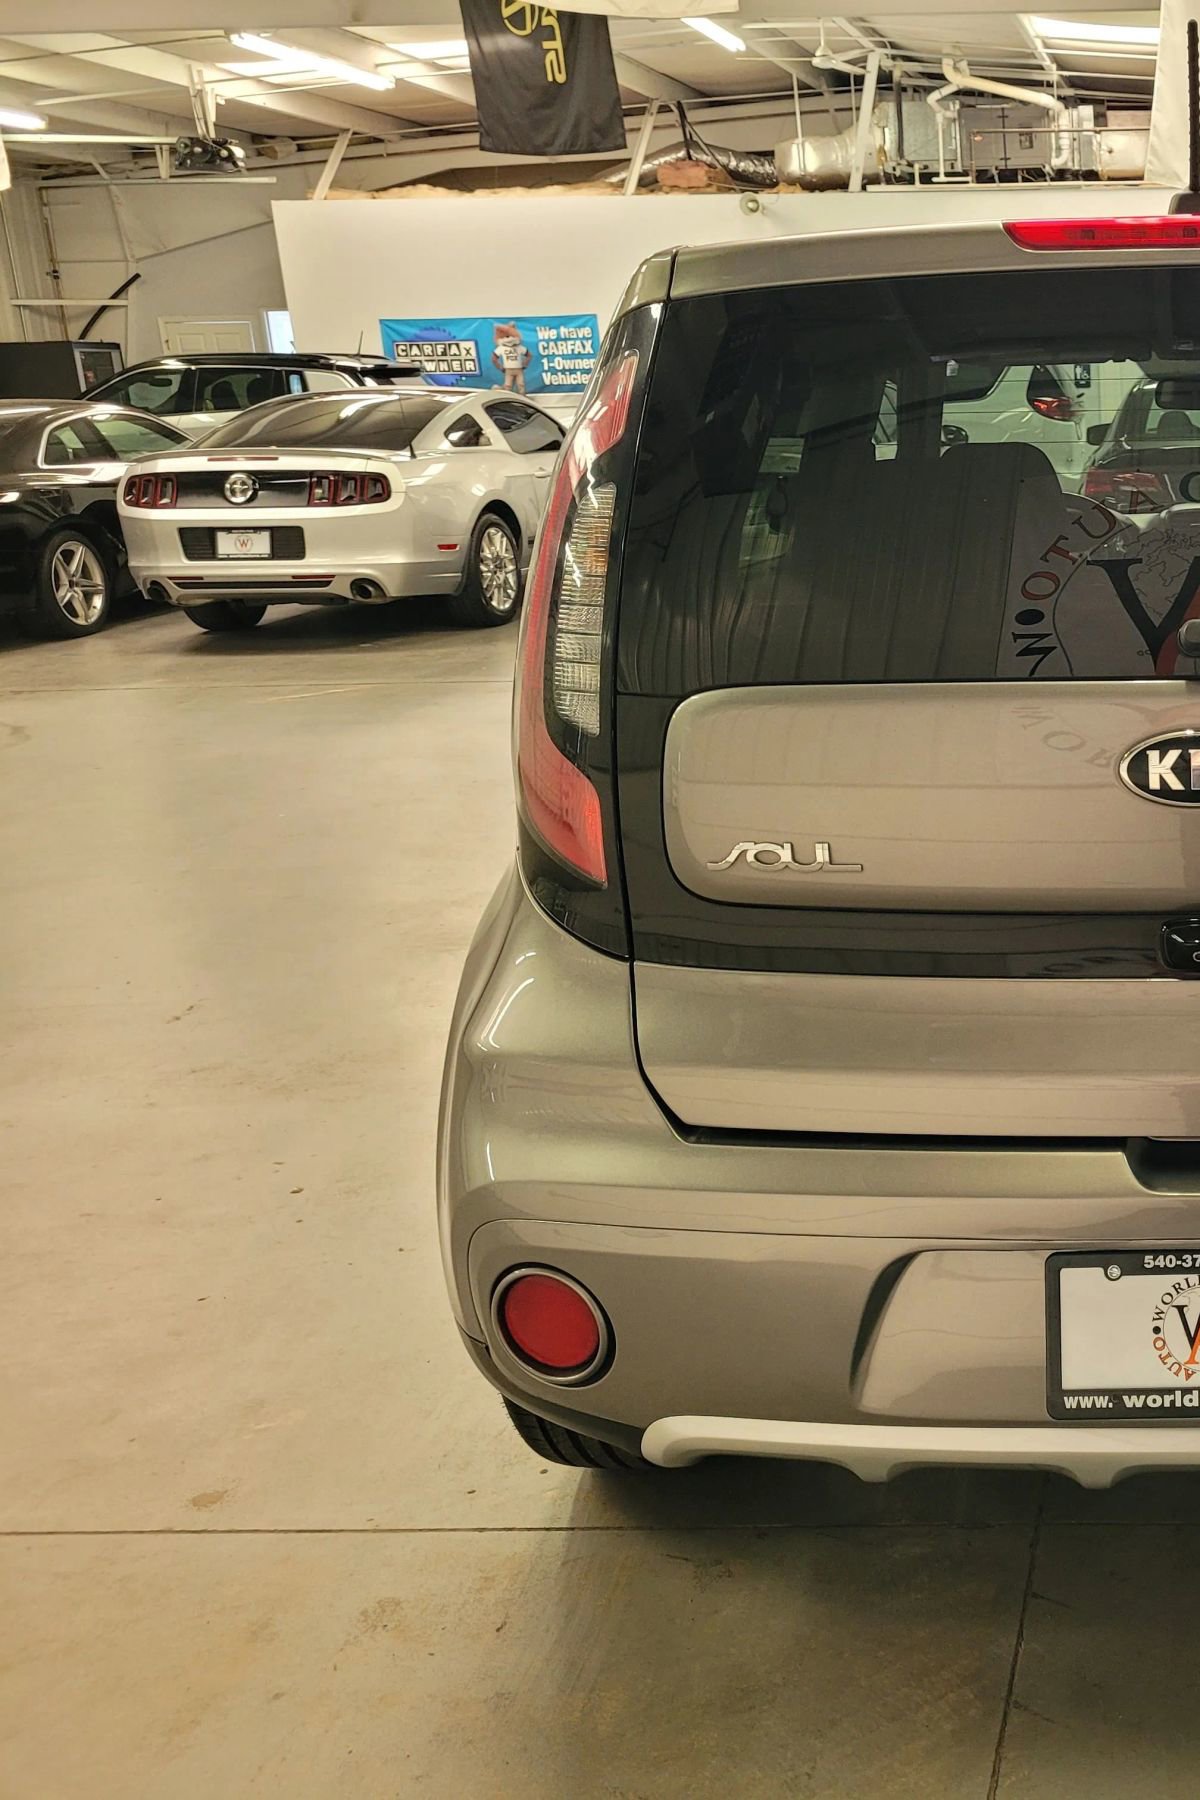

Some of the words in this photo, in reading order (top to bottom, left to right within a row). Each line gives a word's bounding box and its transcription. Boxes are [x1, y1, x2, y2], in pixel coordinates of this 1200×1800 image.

[536, 326, 557, 339] We
[560, 326, 592, 339] have
[395, 343, 475, 358] CARFAX
[538, 340, 594, 356] CARFAX
[416, 360, 476, 372] WNER
[542, 371, 591, 386] Vehicle
